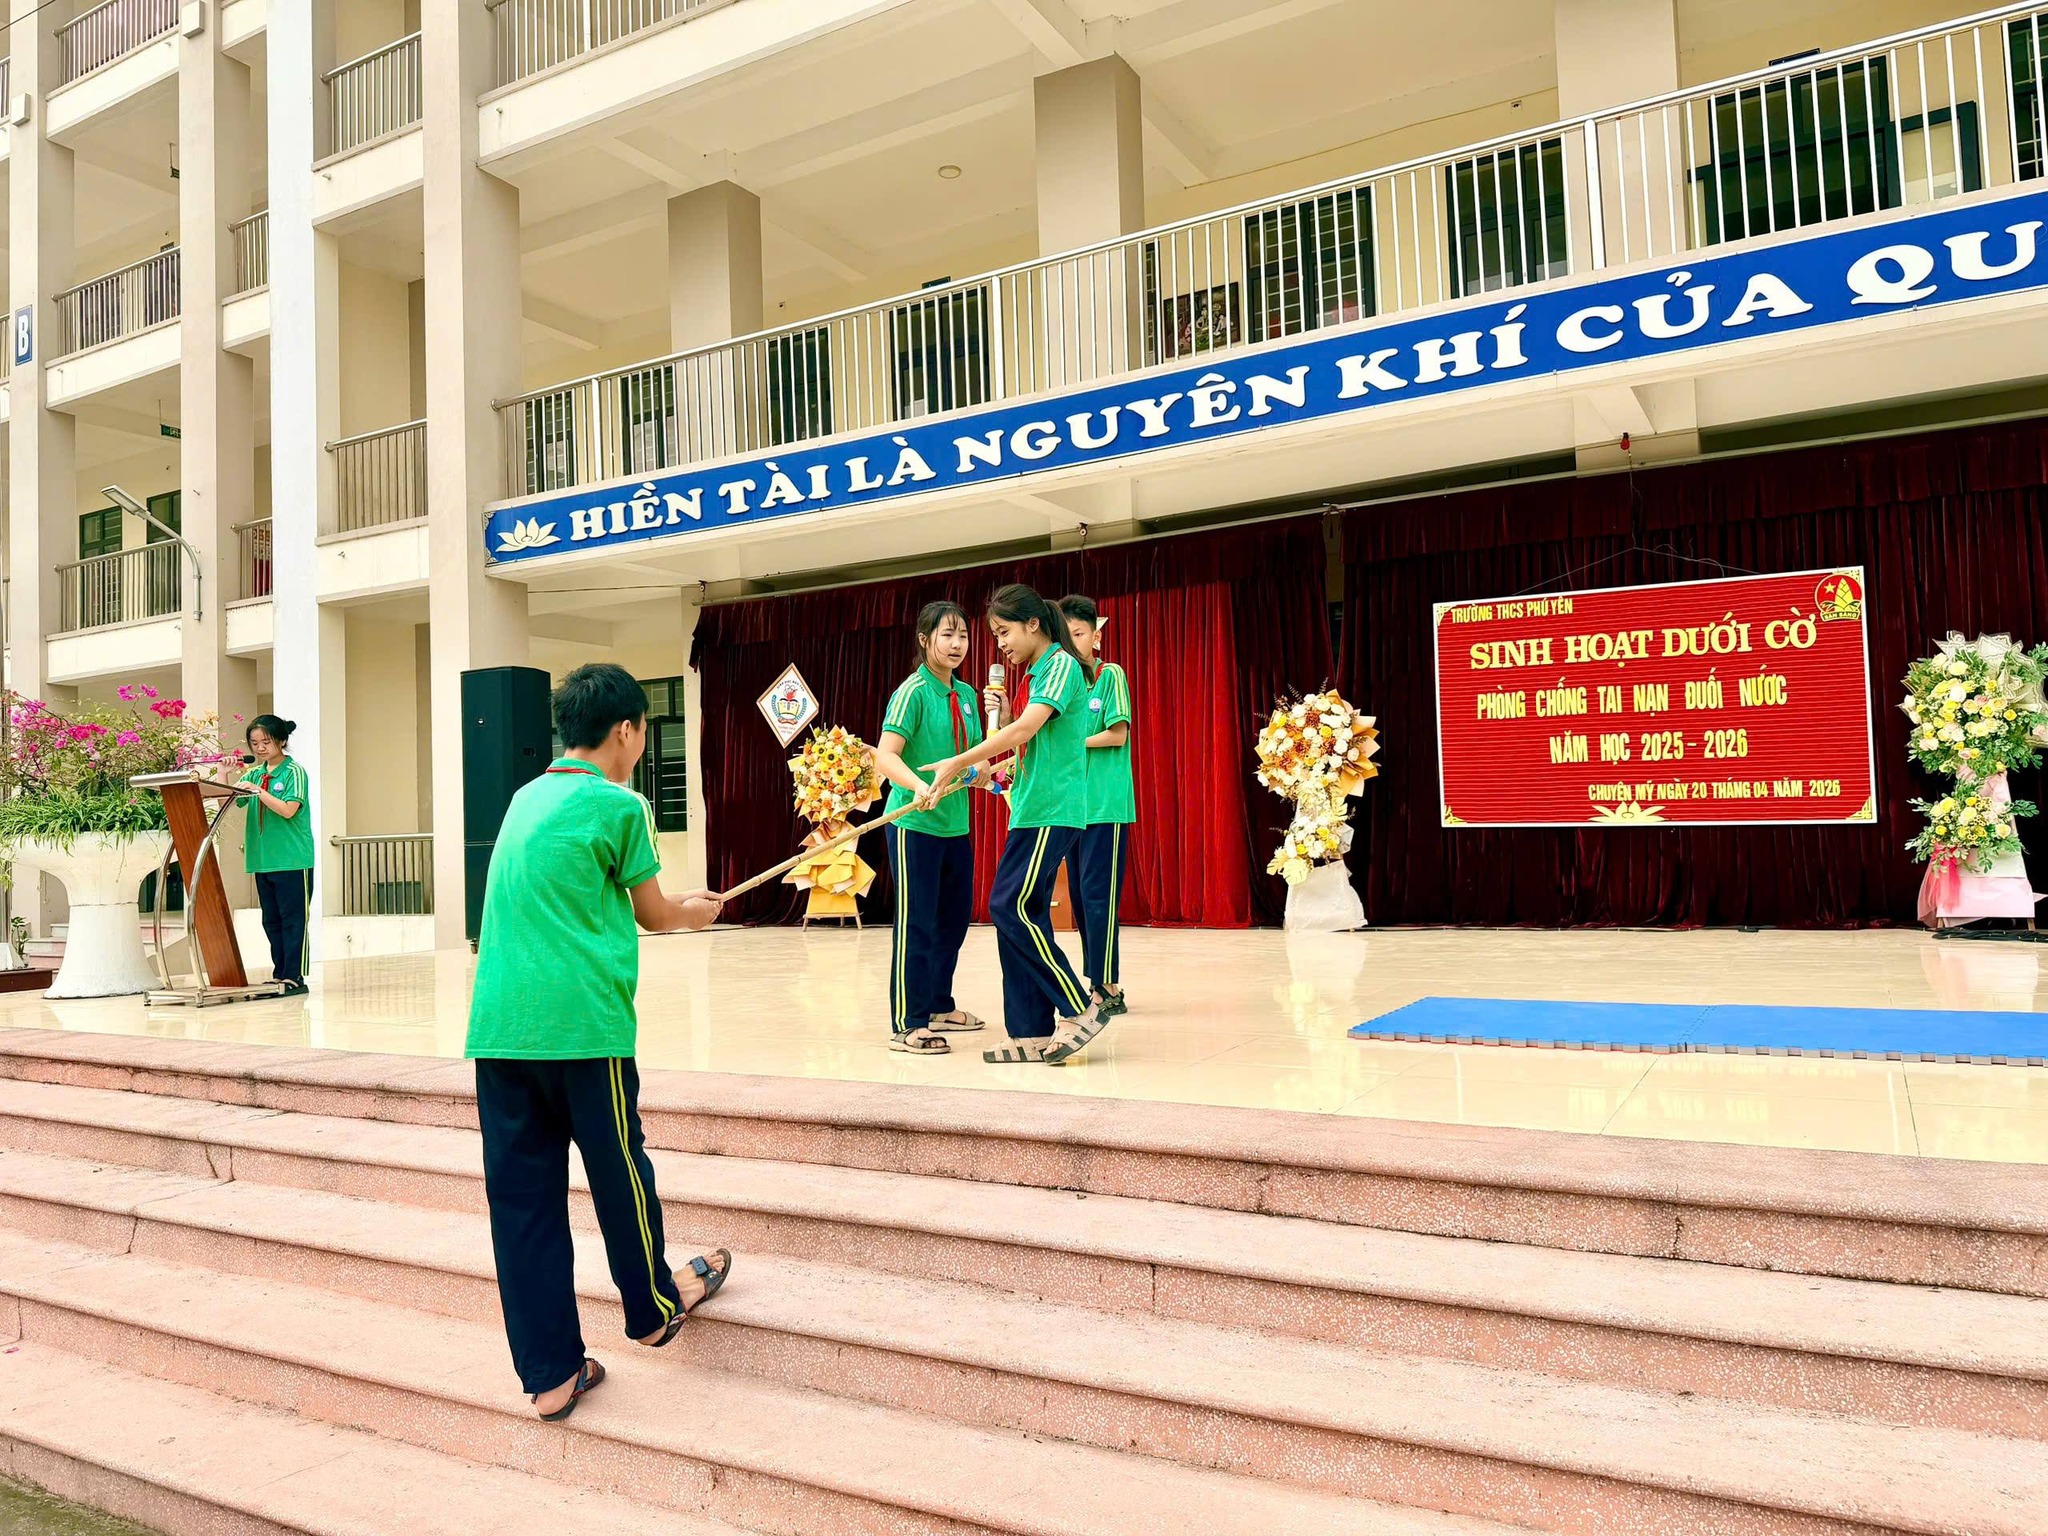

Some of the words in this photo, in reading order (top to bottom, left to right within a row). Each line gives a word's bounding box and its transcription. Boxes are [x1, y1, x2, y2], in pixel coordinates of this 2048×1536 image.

[18, 314, 28, 357] B
[569, 481, 704, 541] HIỀN
[718, 461, 830, 515] TÀI
[847, 436, 937, 493] LÀ
[953, 365, 1310, 473] NGUYÊN
[1336, 303, 1528, 399] KHÍ
[1555, 271, 1814, 354] CỦA
[1451, 603, 1492, 623] TRƯỜNG
[1495, 600, 1523, 619] THCS
[1526, 597, 1548, 617] PHÚ
[1551, 596, 1573, 615] YÊN
[1470, 638, 1553, 669] SINH
[1564, 630, 1653, 667] HOẠT
[1662, 612, 1752, 656] DƯỚI
[1765, 607, 1816, 649] CỜ
[1478, 685, 1526, 719] PHÒNG
[1536, 677, 1587, 717] CHỐNG
[1597, 686, 1622, 713] TAI
[1633, 684, 1668, 716] NẠN
[1685, 667, 1723, 709] ĐUỐI
[1739, 665, 1787, 706] NƯỚC
[1550, 730, 1588, 763] NĂM
[1600, 733, 1630, 765] HỌC
[1704, 729, 1748, 758] 2026
[1588, 781, 1632, 802] CHUYÊN
[1657, 778, 1688, 800] NGÀY
[1692, 782, 1707, 798] 20
[1712, 777, 1751, 798] THÁNG
[1753, 781, 1768, 798] 04
[1773, 777, 1802, 797] NĂM
[1809, 780, 1840, 797] 2026
